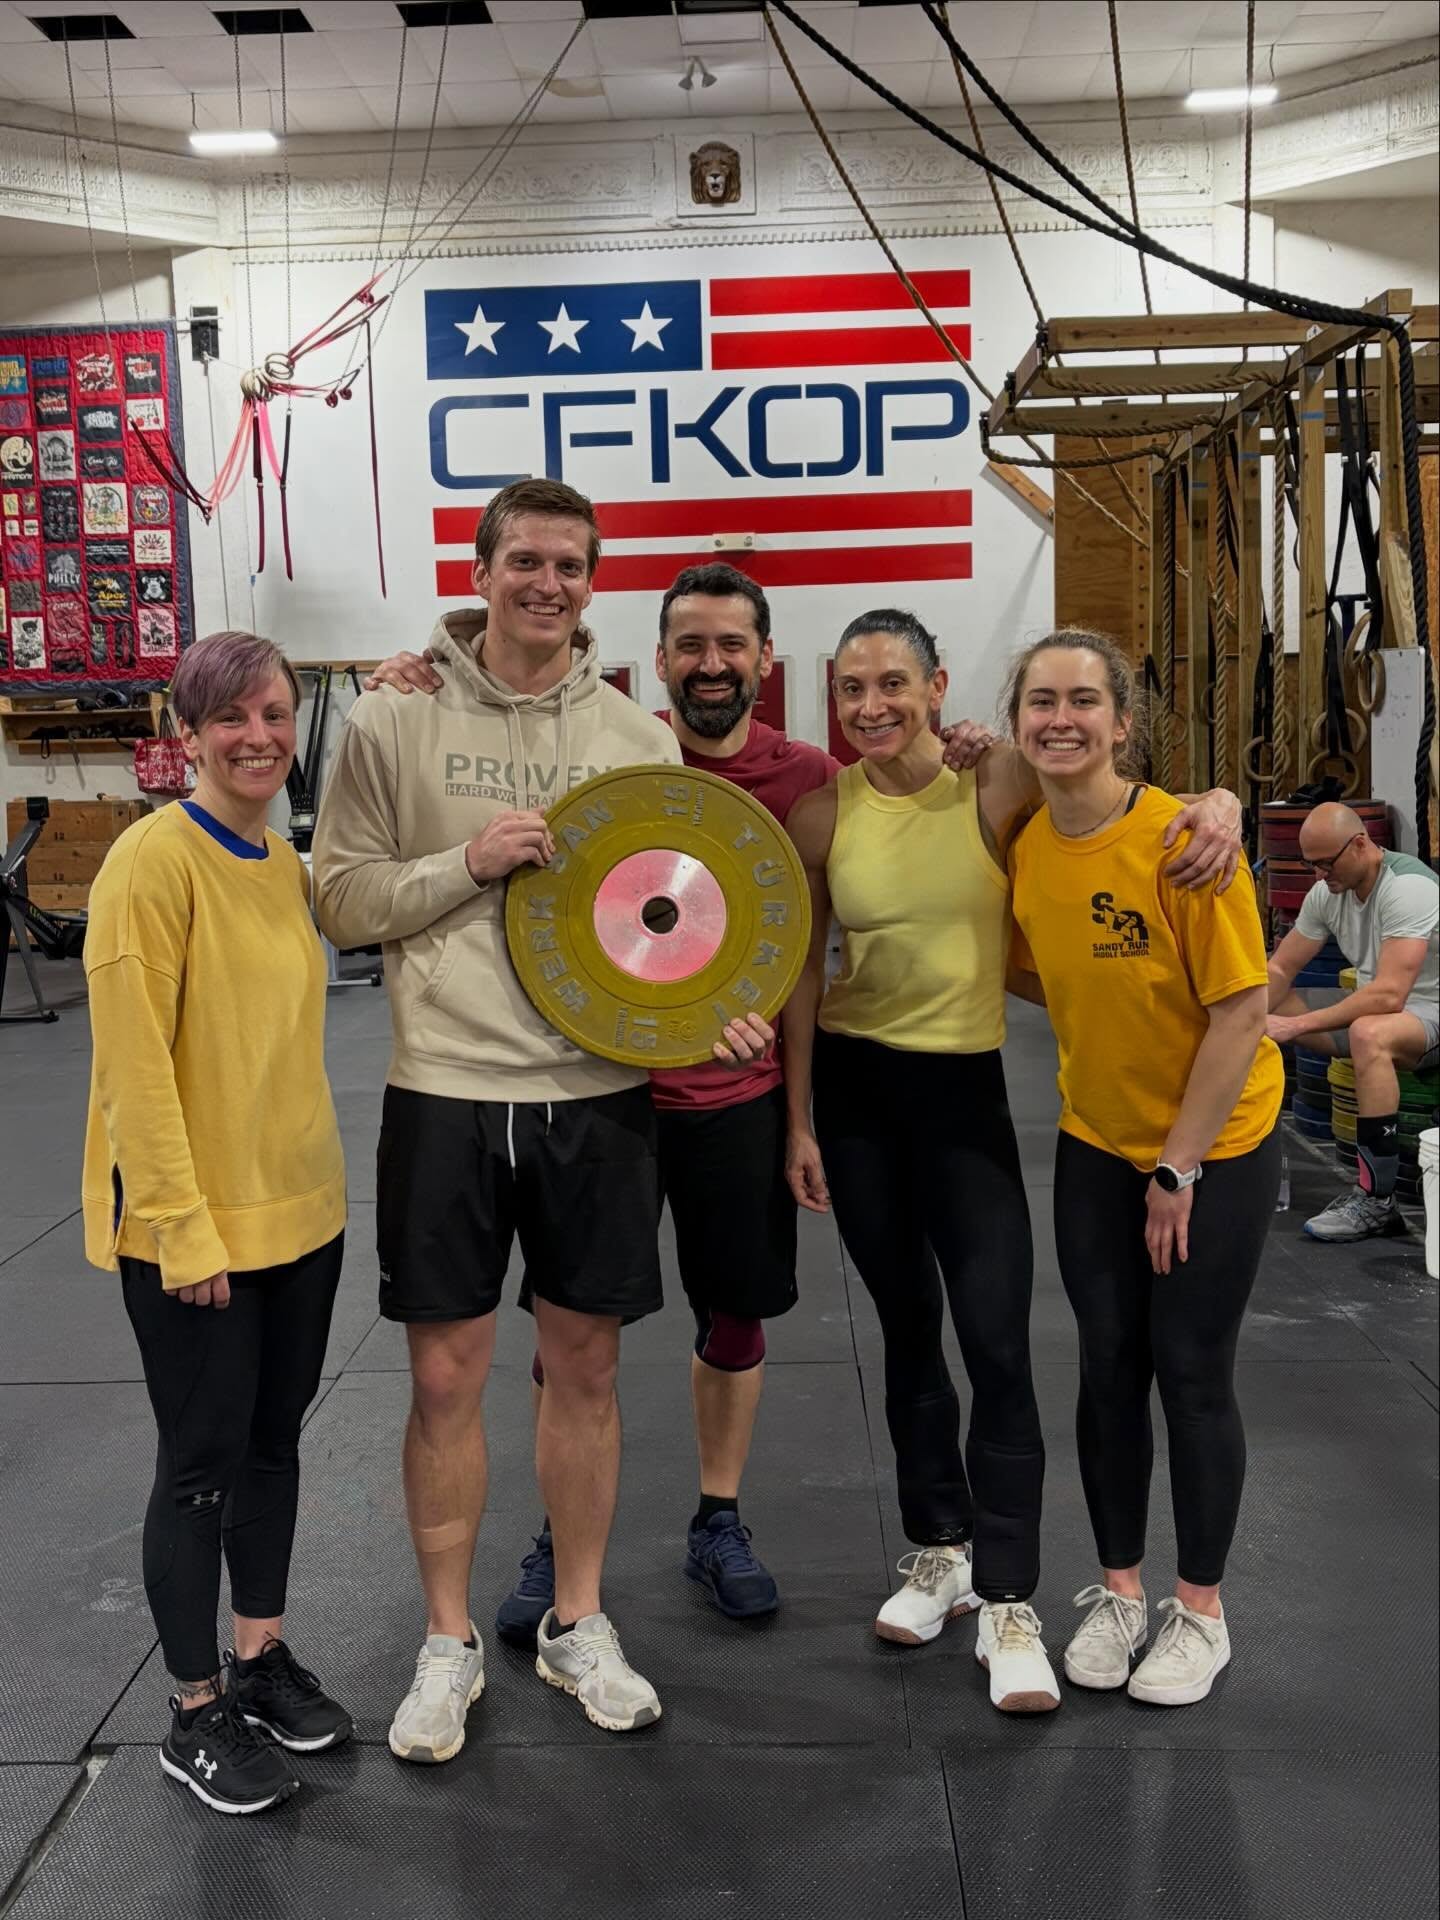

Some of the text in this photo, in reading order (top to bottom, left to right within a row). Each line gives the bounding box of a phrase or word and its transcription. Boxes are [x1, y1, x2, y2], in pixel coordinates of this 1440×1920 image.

[428, 378, 971, 489] CFKOP
[446, 784, 491, 797] HARD
[662, 783, 690, 817] 15
[1092, 941, 1150, 952] SANDY RUN
[1093, 949, 1150, 959] MIDDLE SCHOOL
[630, 1014, 657, 1050] 15
